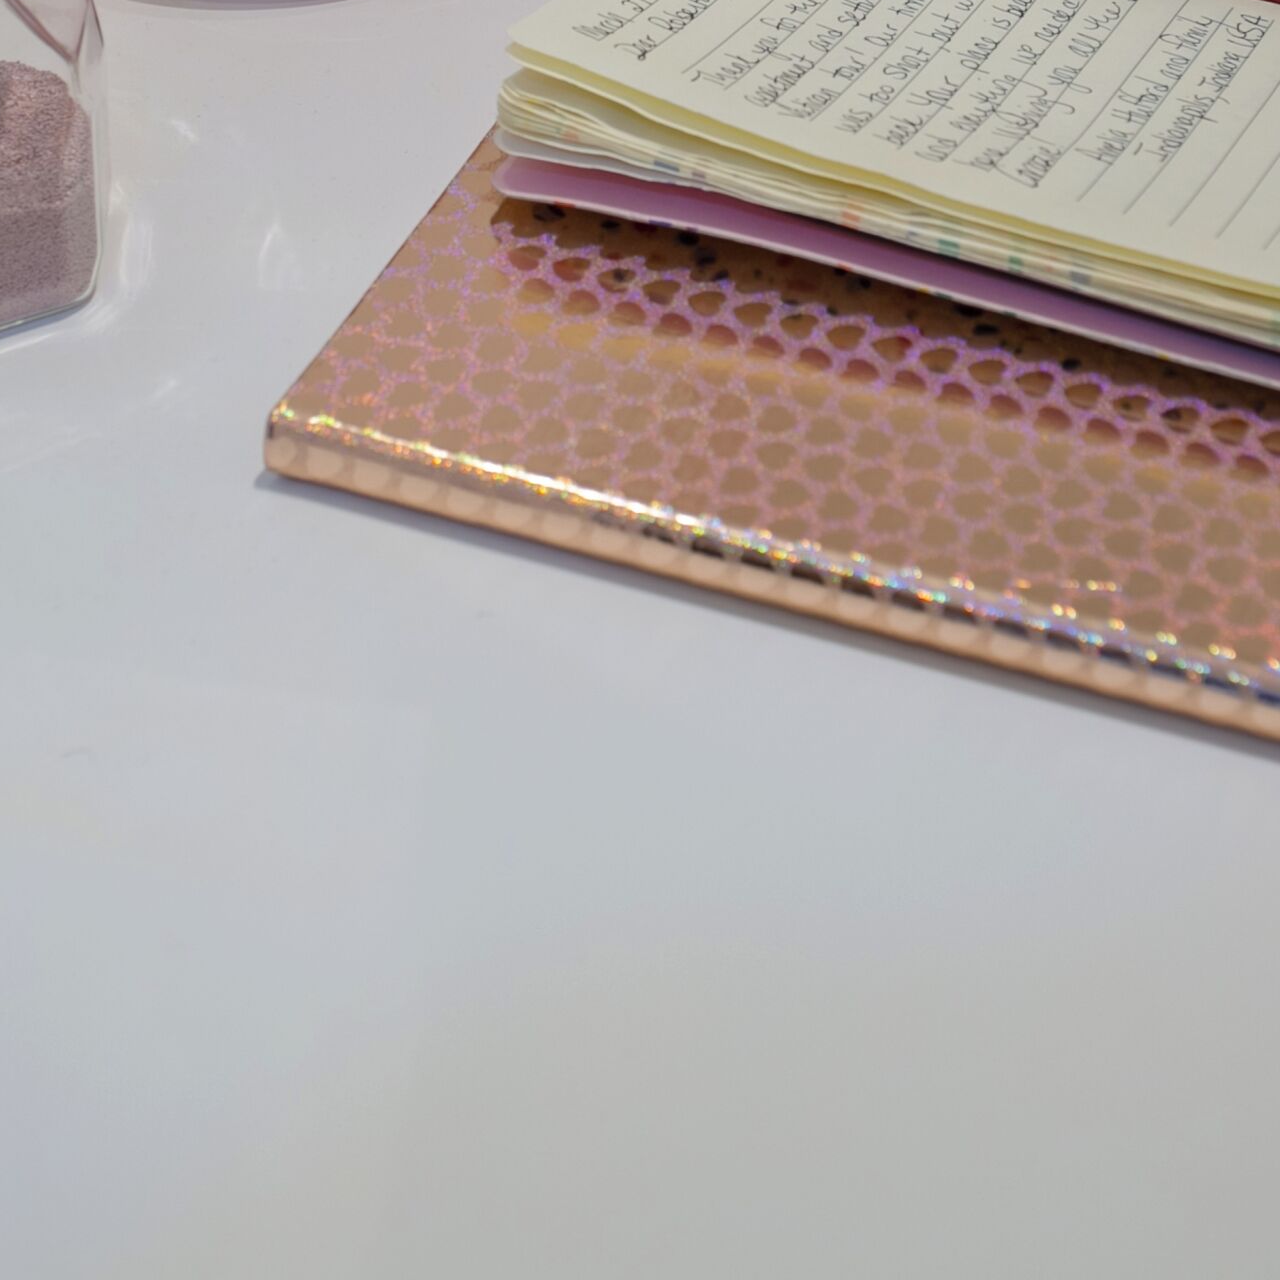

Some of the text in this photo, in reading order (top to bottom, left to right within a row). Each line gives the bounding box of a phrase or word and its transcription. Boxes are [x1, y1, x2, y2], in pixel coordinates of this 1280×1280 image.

[808, 22, 844, 55] and
[863, 23, 899, 48] Our
[1068, 32, 1104, 59] all
[1226, 12, 1269, 49] USA
[690, 51, 762, 88] Thank
[751, 35, 794, 62] you
[857, 83, 896, 108] too
[913, 12, 961, 43] but
[906, 74, 961, 111] Your
[956, 35, 1001, 76] place
[991, 17, 1012, 31] is
[1159, 50, 1192, 82] and
[1047, 64, 1093, 95] you
[914, 133, 958, 163] and
[1010, 43, 1046, 66] we
